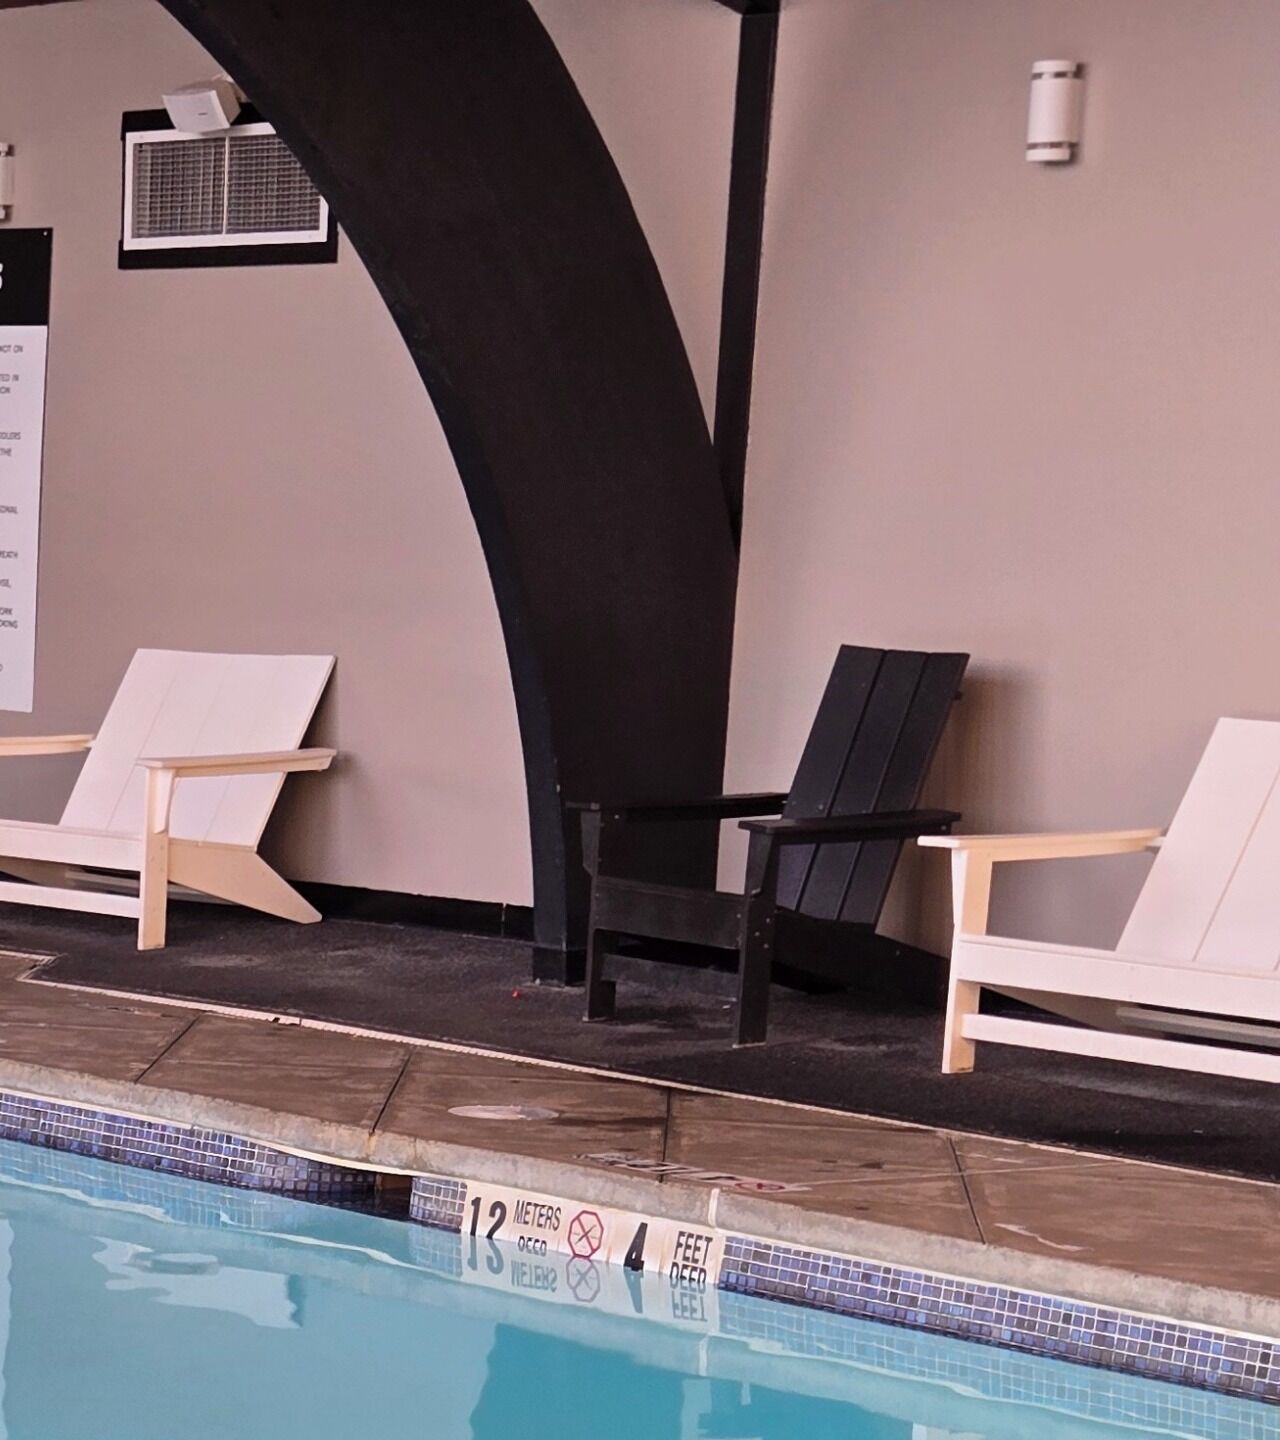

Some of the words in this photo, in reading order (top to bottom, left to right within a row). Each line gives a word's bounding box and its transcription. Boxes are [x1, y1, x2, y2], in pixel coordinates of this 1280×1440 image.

[513, 1199, 562, 1231] METERS
[623, 1222, 648, 1271] 4
[673, 1230, 713, 1266] FEET
